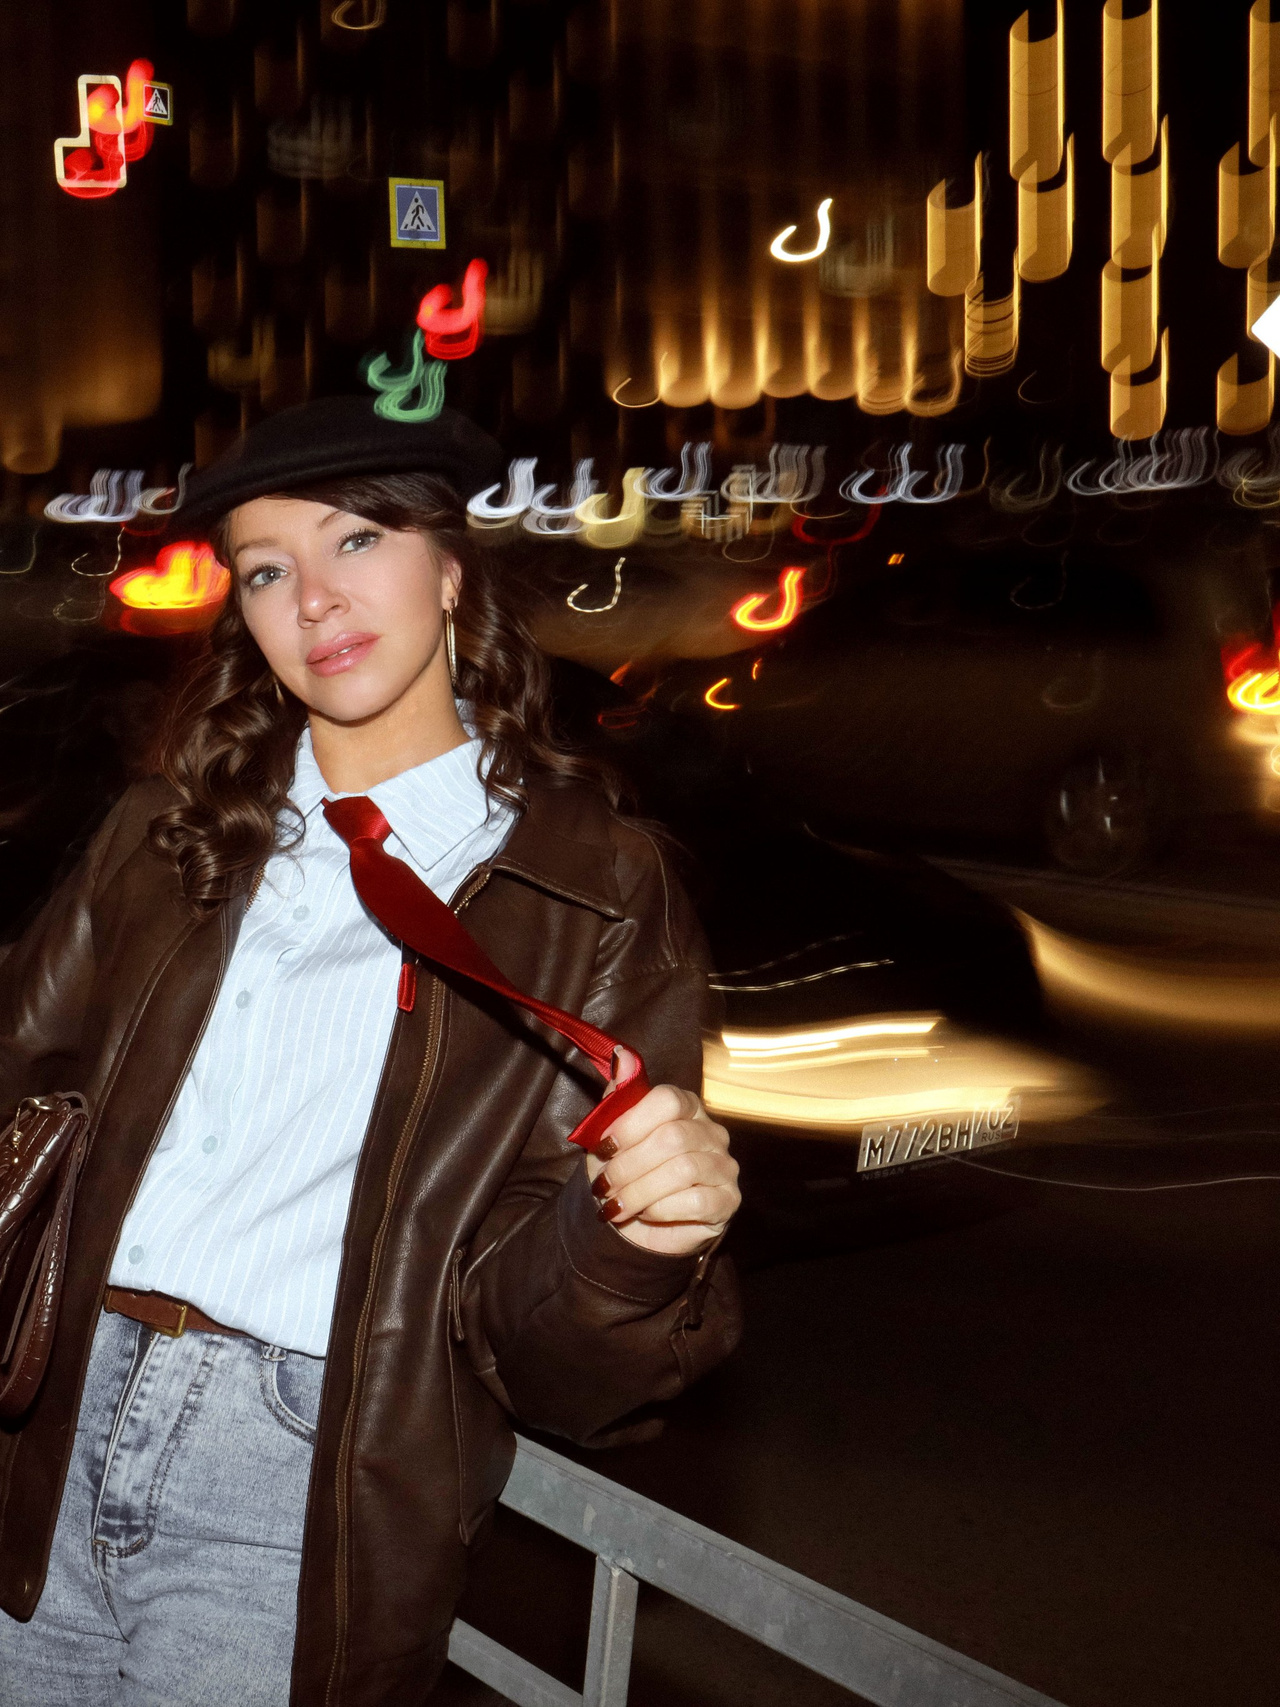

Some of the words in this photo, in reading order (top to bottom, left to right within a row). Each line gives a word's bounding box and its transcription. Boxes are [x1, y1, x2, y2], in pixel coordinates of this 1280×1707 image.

[864, 1117, 970, 1167] M772BH
[981, 1130, 1001, 1142] RUS
[862, 1166, 905, 1181] NISSAN
